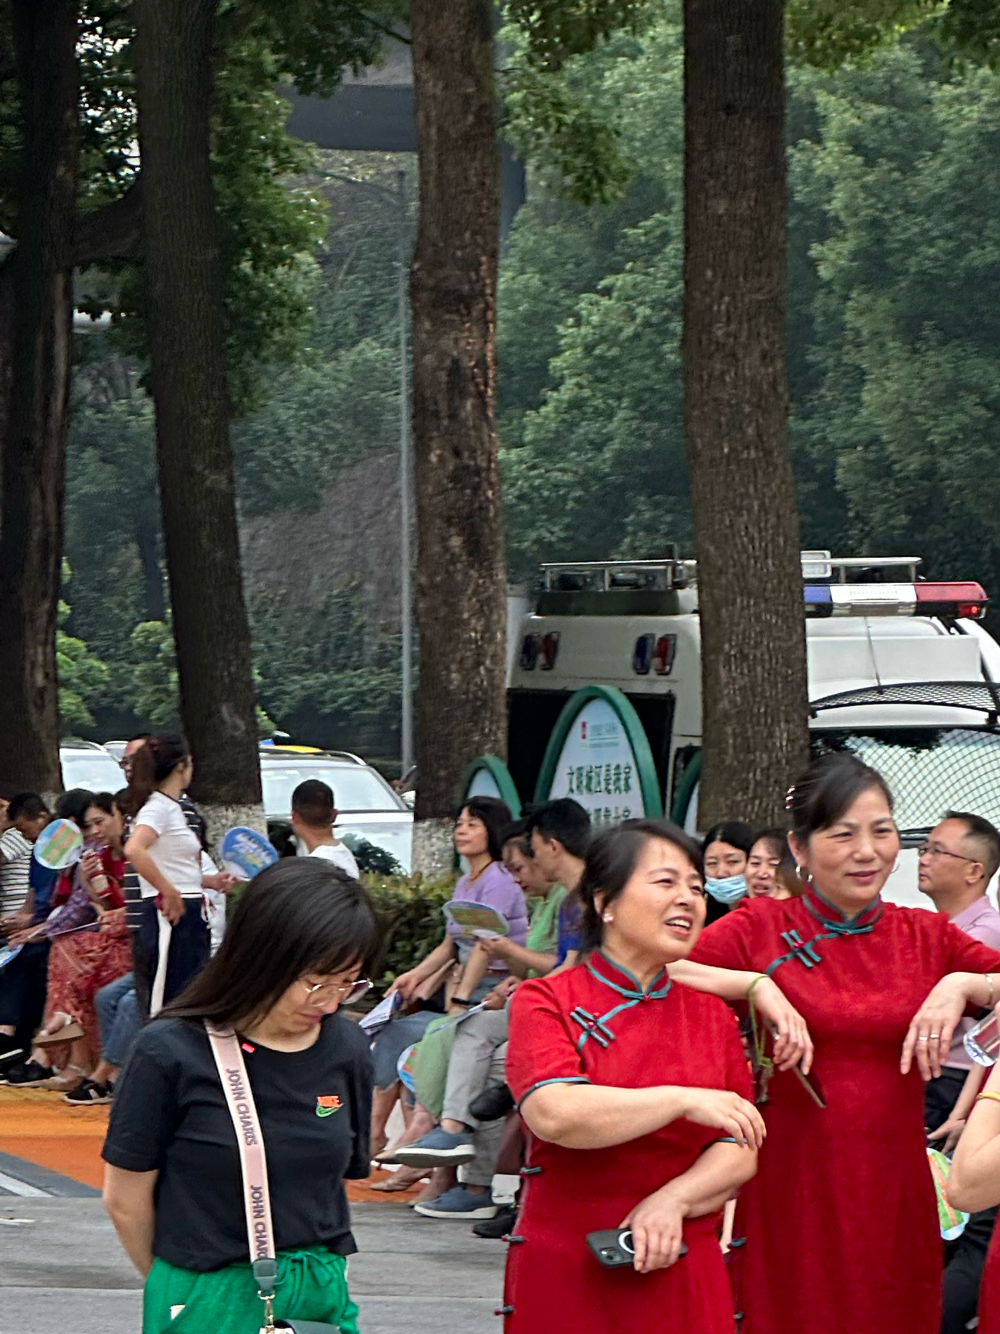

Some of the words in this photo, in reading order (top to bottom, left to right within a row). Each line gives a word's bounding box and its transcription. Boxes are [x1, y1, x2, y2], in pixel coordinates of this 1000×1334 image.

[226, 1068, 243, 1101] JOHN
[251, 1184, 266, 1219] JOHN
[255, 1221, 269, 1259] CHAR
